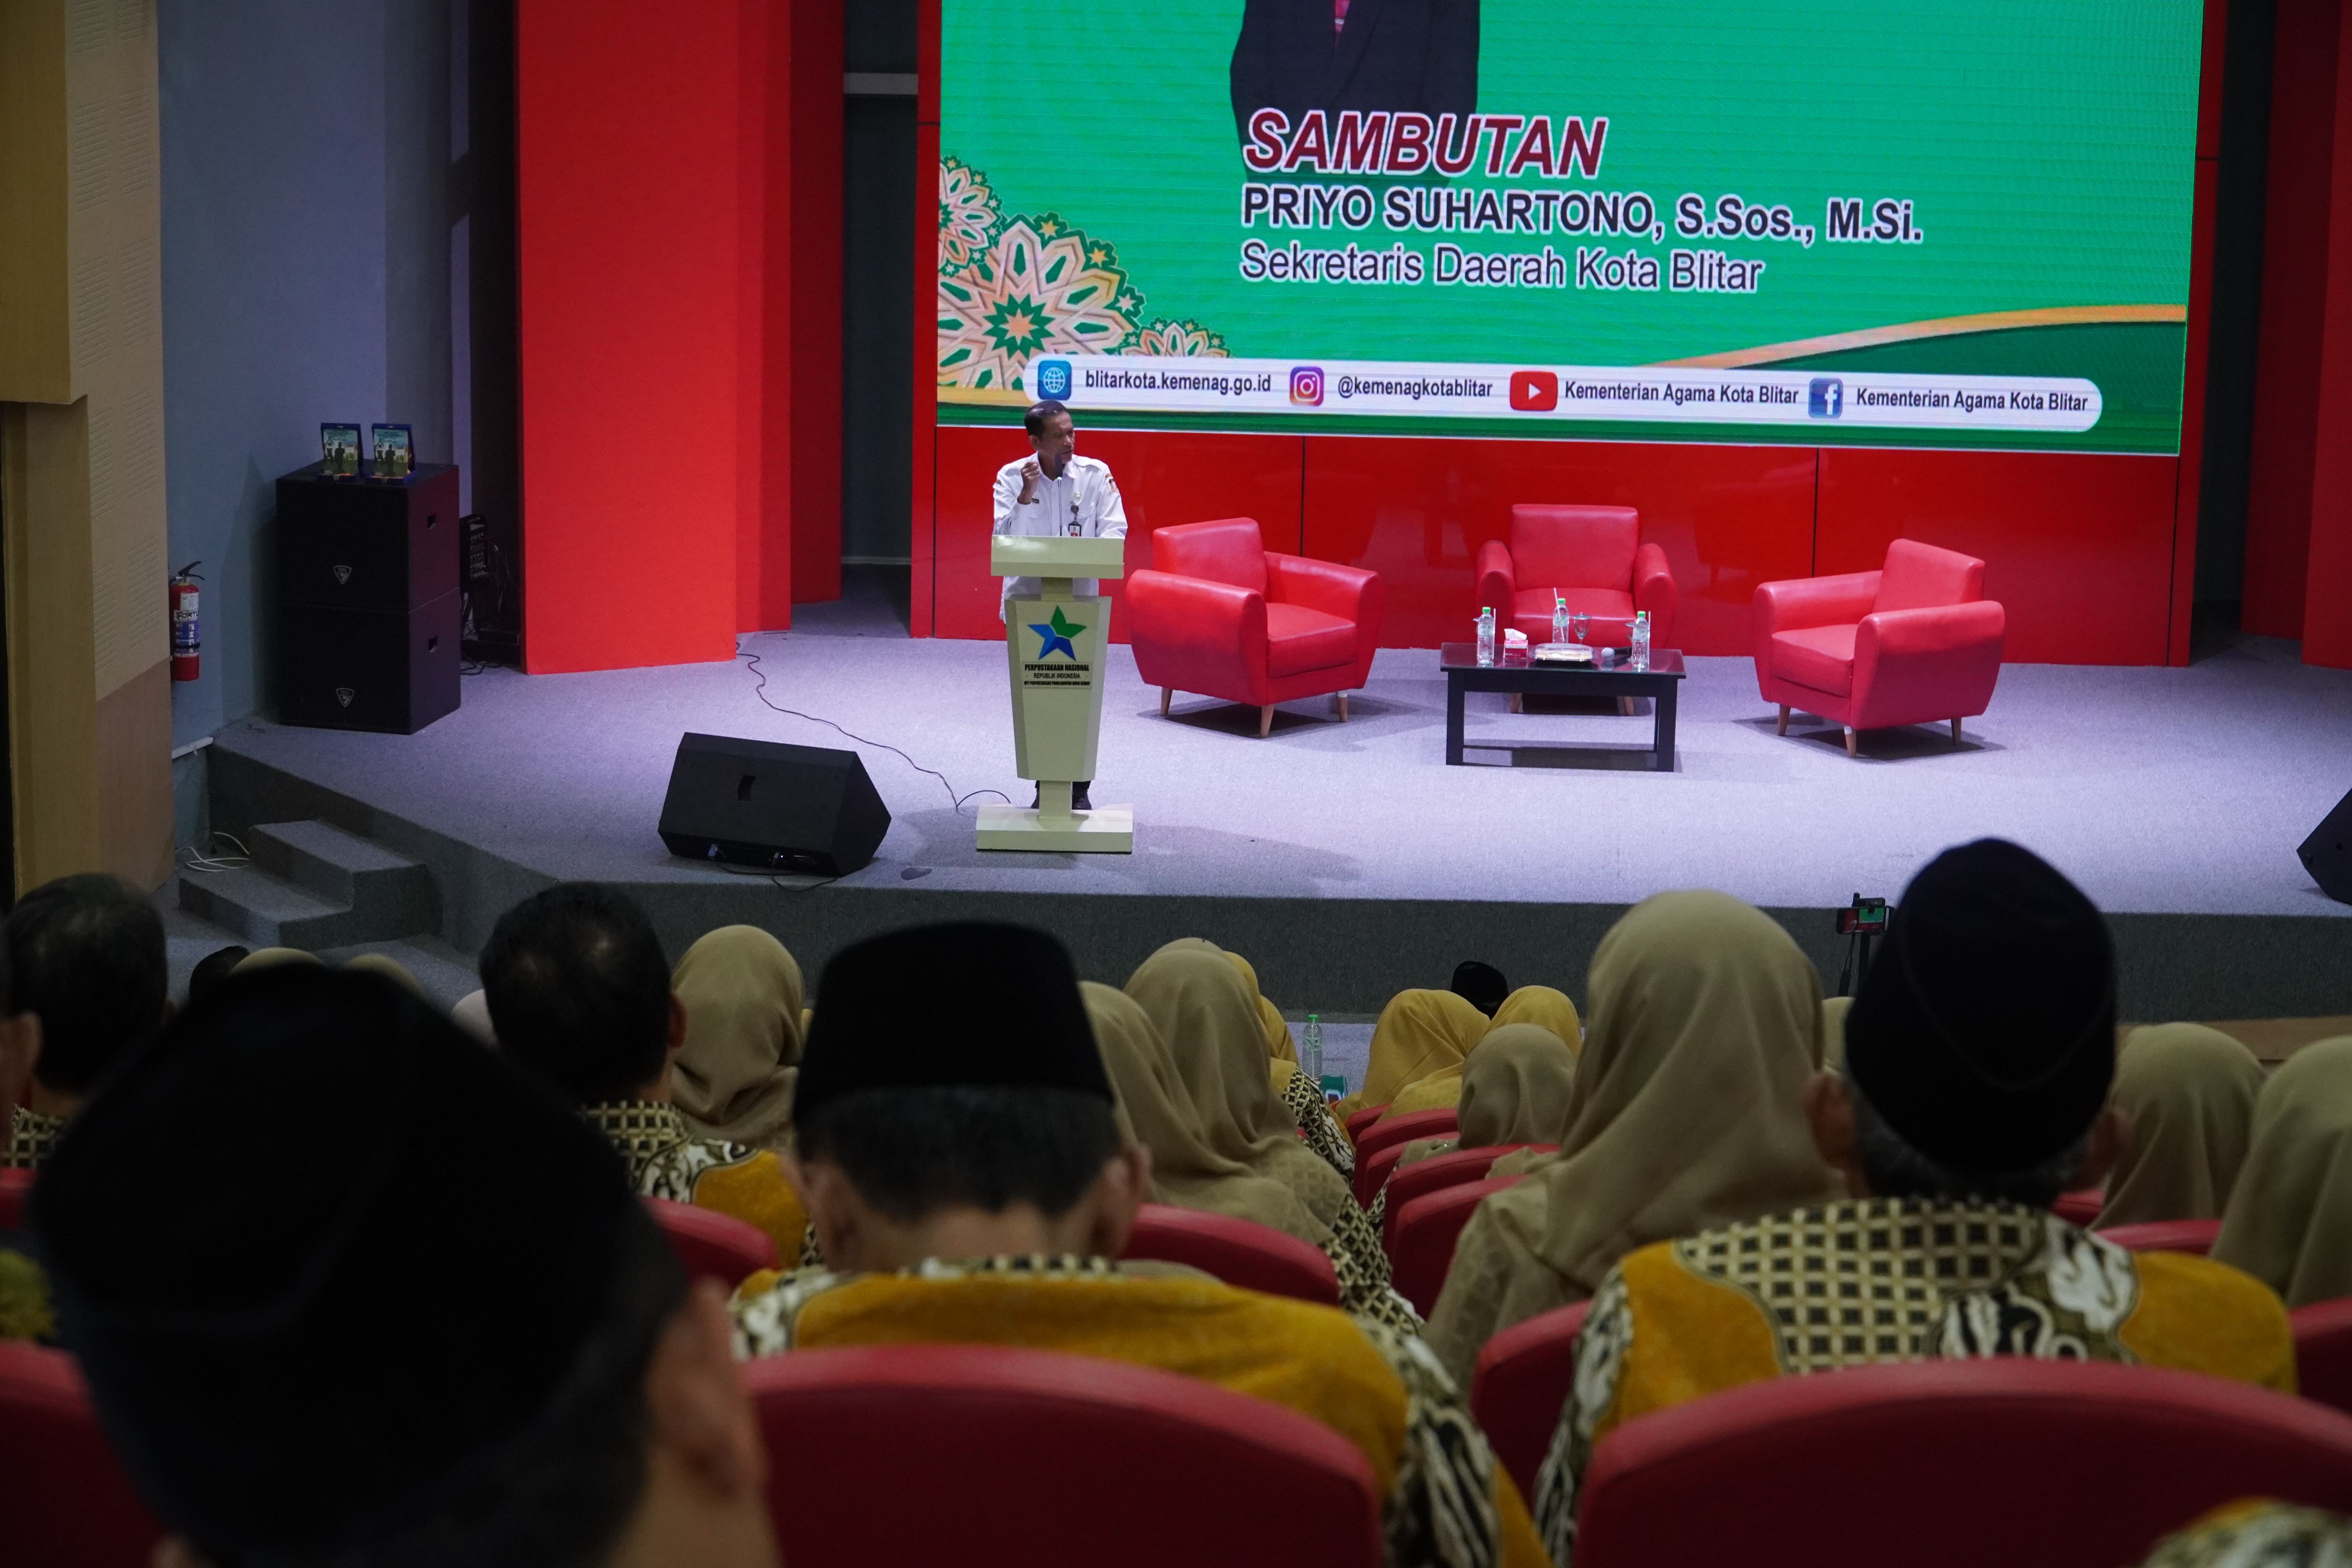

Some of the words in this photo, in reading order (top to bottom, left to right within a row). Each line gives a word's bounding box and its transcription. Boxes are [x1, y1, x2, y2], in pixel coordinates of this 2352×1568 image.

[1245, 110, 1608, 177] SAMBUTAN
[1243, 187, 1373, 227] PRIYO
[1384, 189, 1663, 241] SUHARTONO,
[1677, 196, 1814, 245] S.Sos.,
[1828, 201, 1922, 240] M.Si.
[1241, 241, 1423, 281] Sekretaris
[1435, 246, 1564, 285] Daerah
[1578, 250, 1659, 287] Kota
[1672, 251, 1764, 290] Blitar
[1086, 370, 1271, 396] blitarkota.kemenag.go.id
[1338, 376, 1493, 400] @kemenagkotablitar
[1565, 381, 1659, 400] Kementerian
[1663, 383, 1715, 405] Agama
[1720, 385, 1754, 403] Kota
[1759, 386, 1799, 404] Blitar
[1857, 388, 1949, 408] Kementerian
[1954, 390, 2005, 413] Agama
[2010, 392, 2044, 410] Kota
[2049, 393, 2088, 411] Blitar
